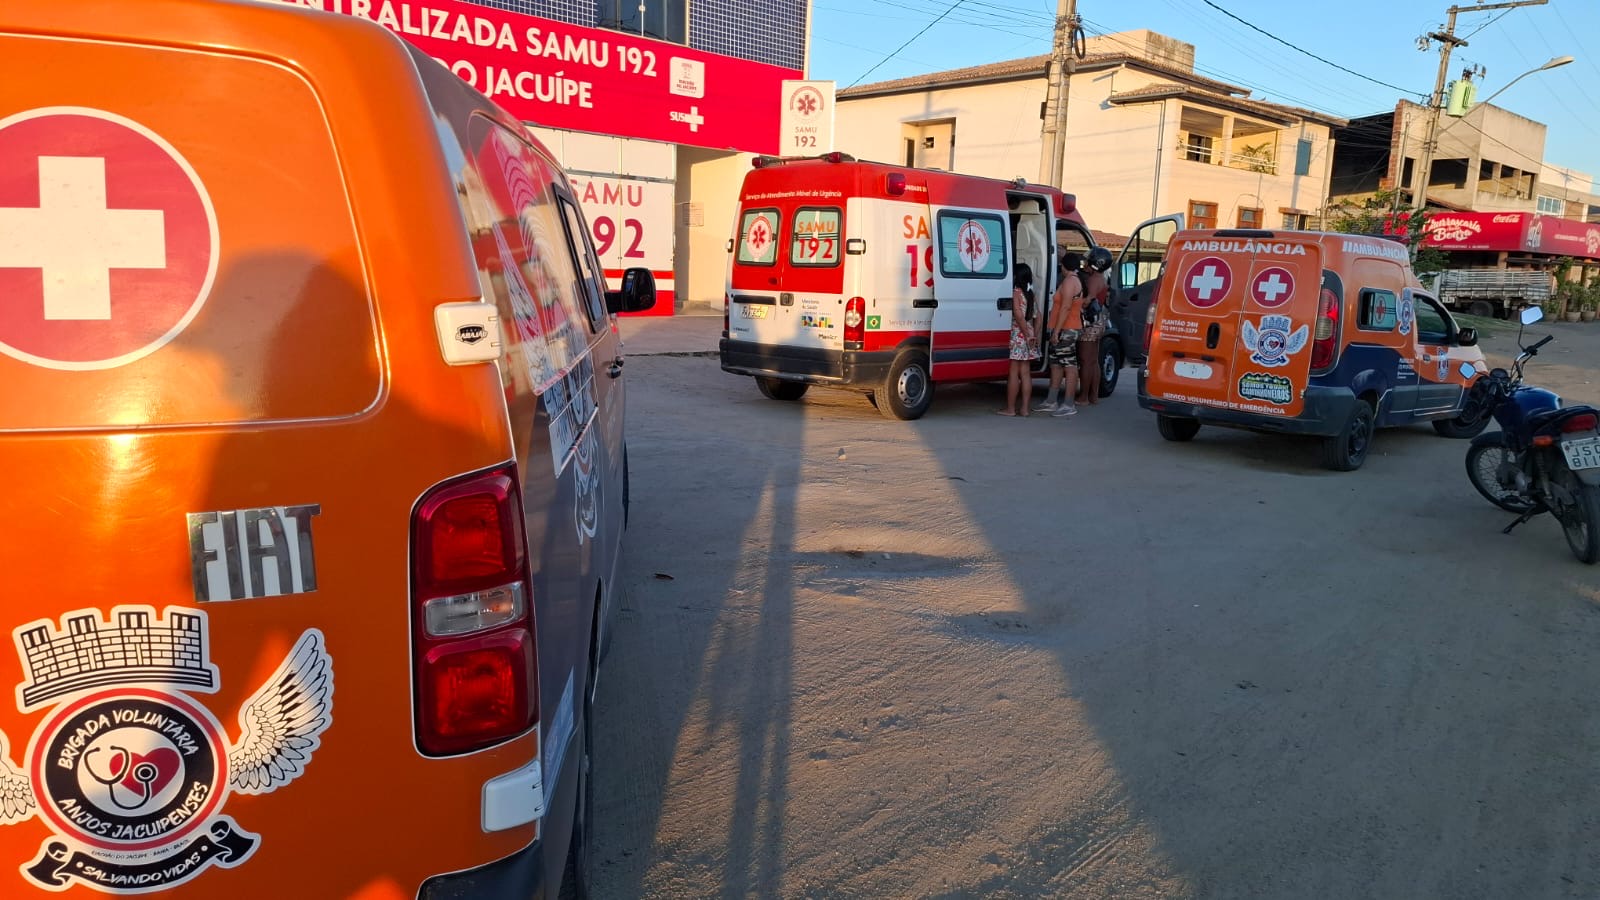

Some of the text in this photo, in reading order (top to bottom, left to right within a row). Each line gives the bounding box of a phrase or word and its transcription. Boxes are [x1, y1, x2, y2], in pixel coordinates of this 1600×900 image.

[526, 27, 609, 68] SAMU
[616, 45, 657, 78] 192
[484, 66, 594, 109] JACUÍPE
[669, 111, 686, 123] SUS
[794, 126, 818, 134] SAMU
[794, 135, 817, 148] 192
[592, 215, 645, 259] 92
[797, 220, 835, 233] SAMU
[903, 214, 931, 240] SA
[798, 237, 834, 259] 192
[1181, 238, 1306, 256] AMBULÂNCIA
[1229, 402, 1239, 410] DE
[1239, 403, 1286, 415] EMERGÊNCIA
[186, 504, 321, 603] FIAT
[57, 709, 199, 770] BRIGADA VOLUNTÁRIA
[57, 781, 208, 839] ANJOS JACUIPENSES
[82, 851, 201, 885] SALVANDO VIDAS
